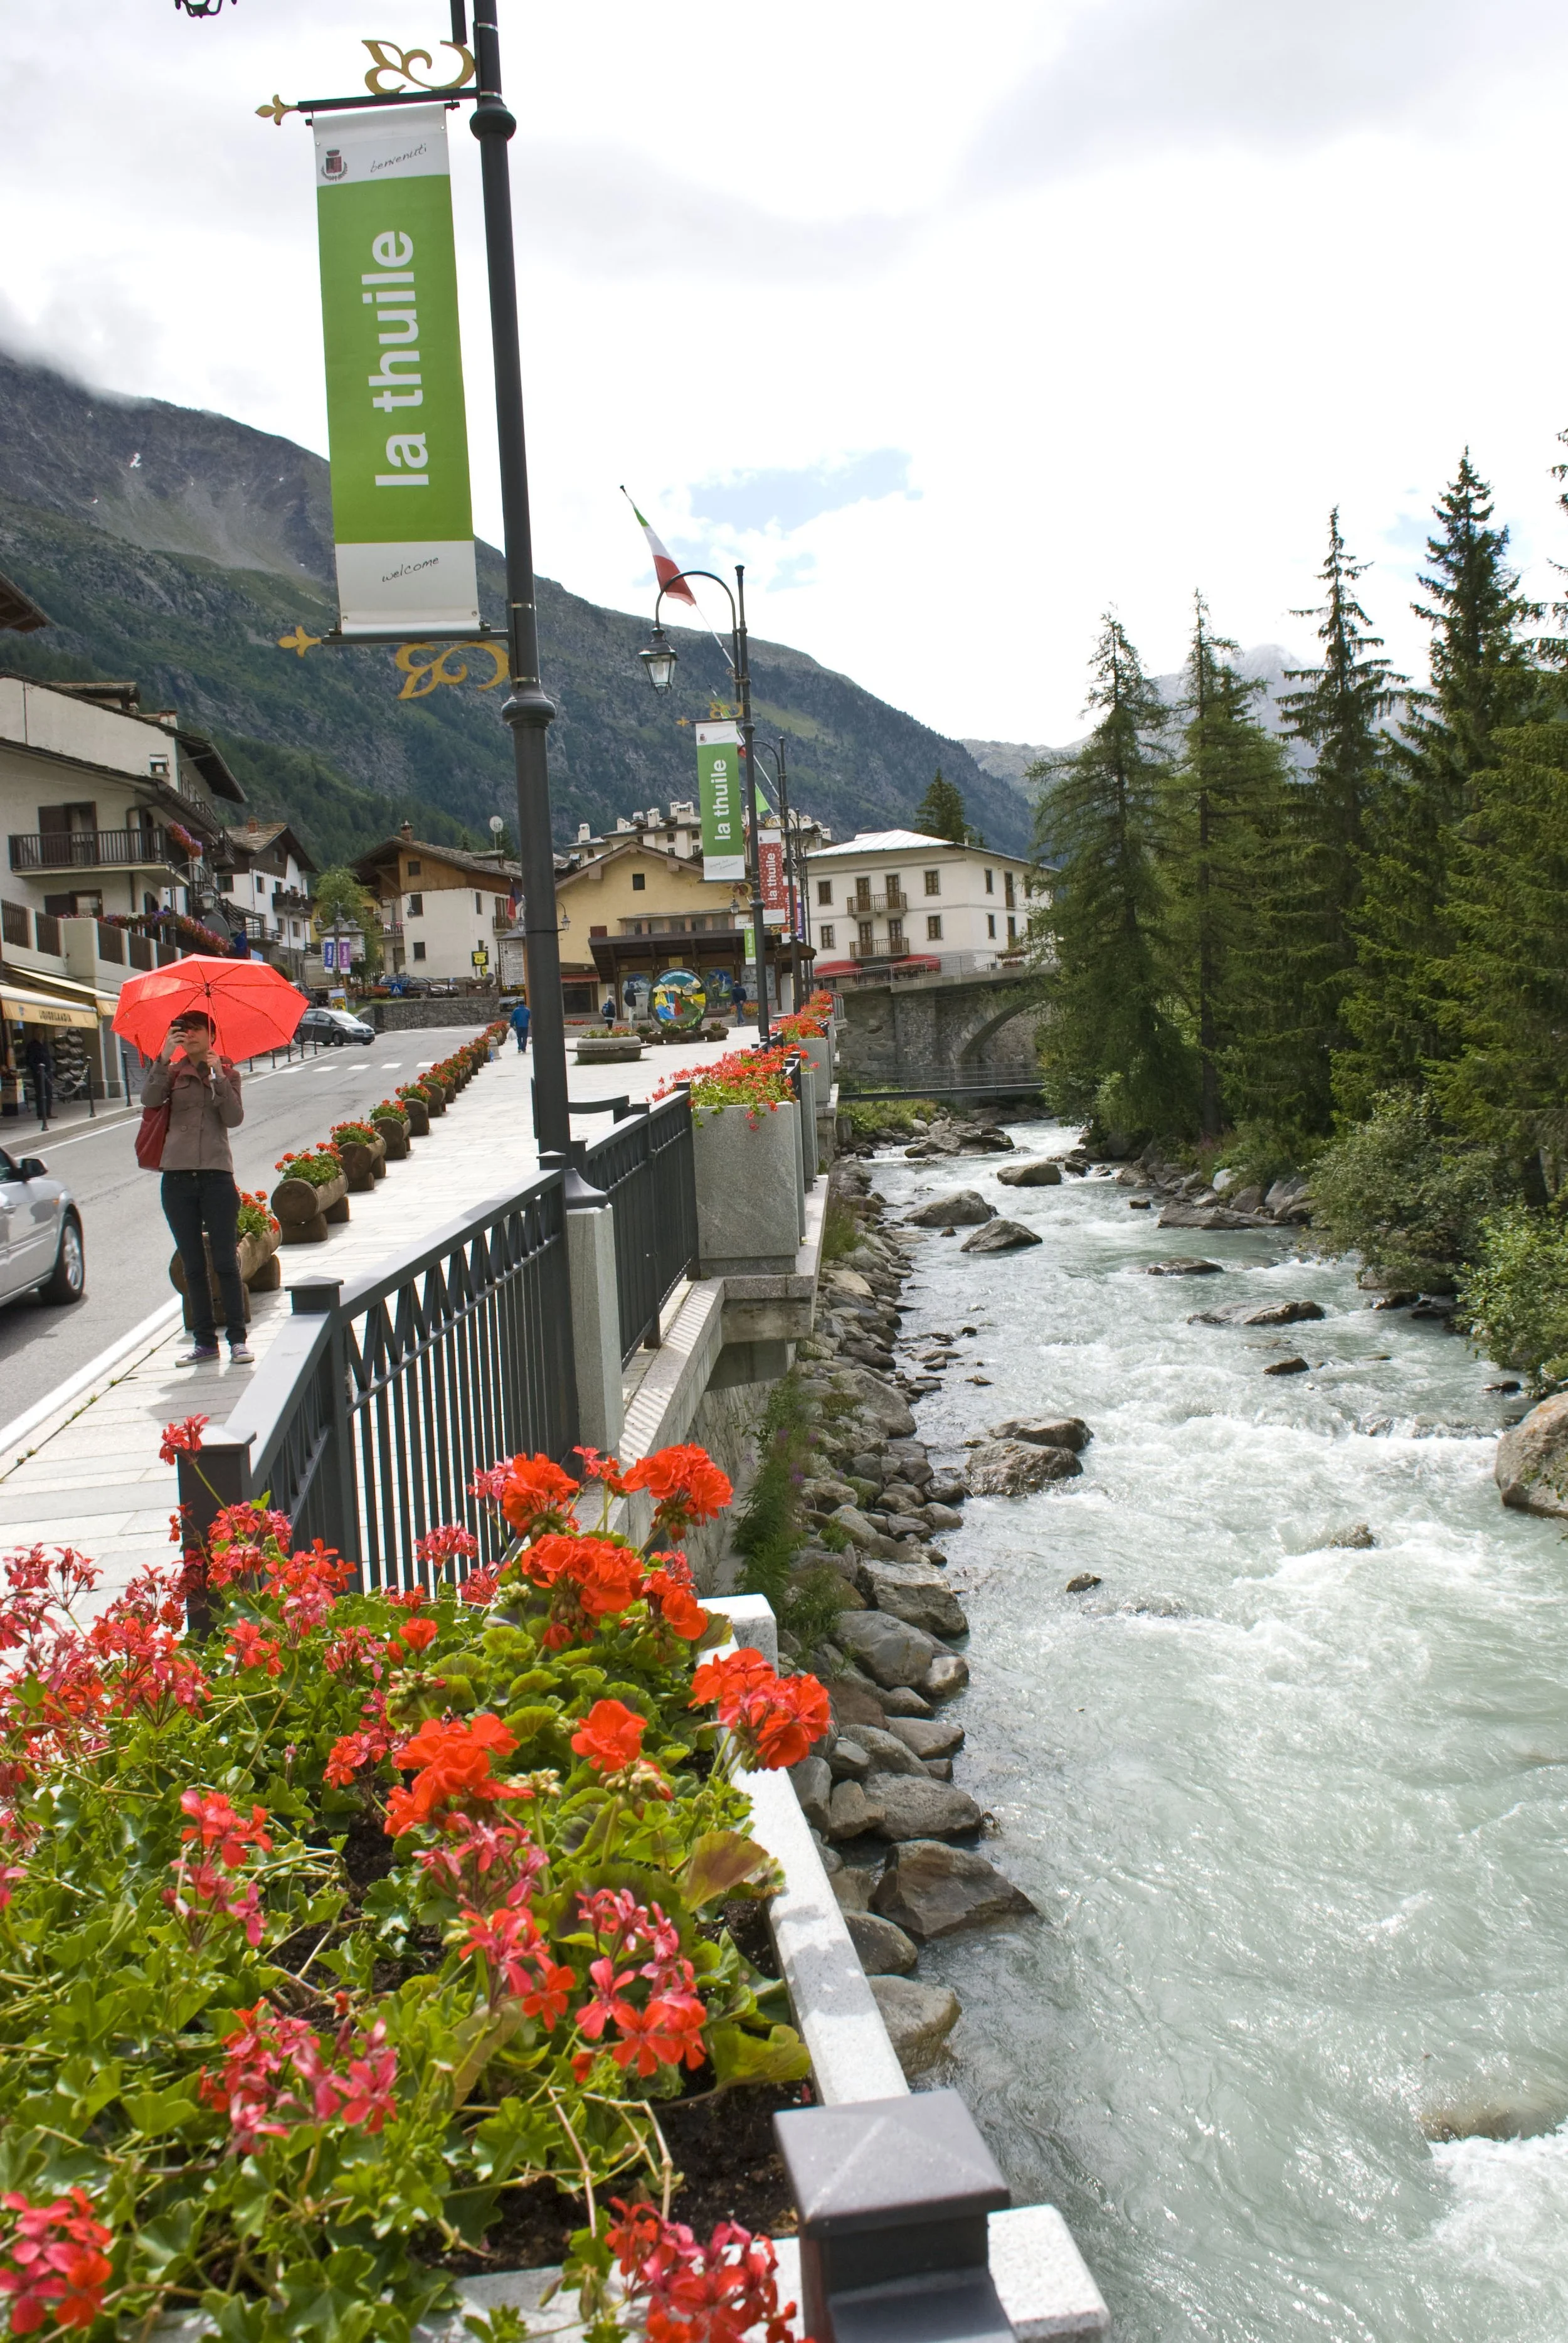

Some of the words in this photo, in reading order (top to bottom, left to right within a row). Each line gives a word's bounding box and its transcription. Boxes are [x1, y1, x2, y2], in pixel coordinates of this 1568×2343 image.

[370, 143, 426, 173] benvenuti
[361, 231, 423, 413] thuile
[374, 432, 429, 486] la
[381, 557, 440, 582] welcome
[710, 759, 729, 817] thuile
[714, 822, 731, 840] la
[765, 853, 777, 887] thuile
[767, 890, 778, 901] la
